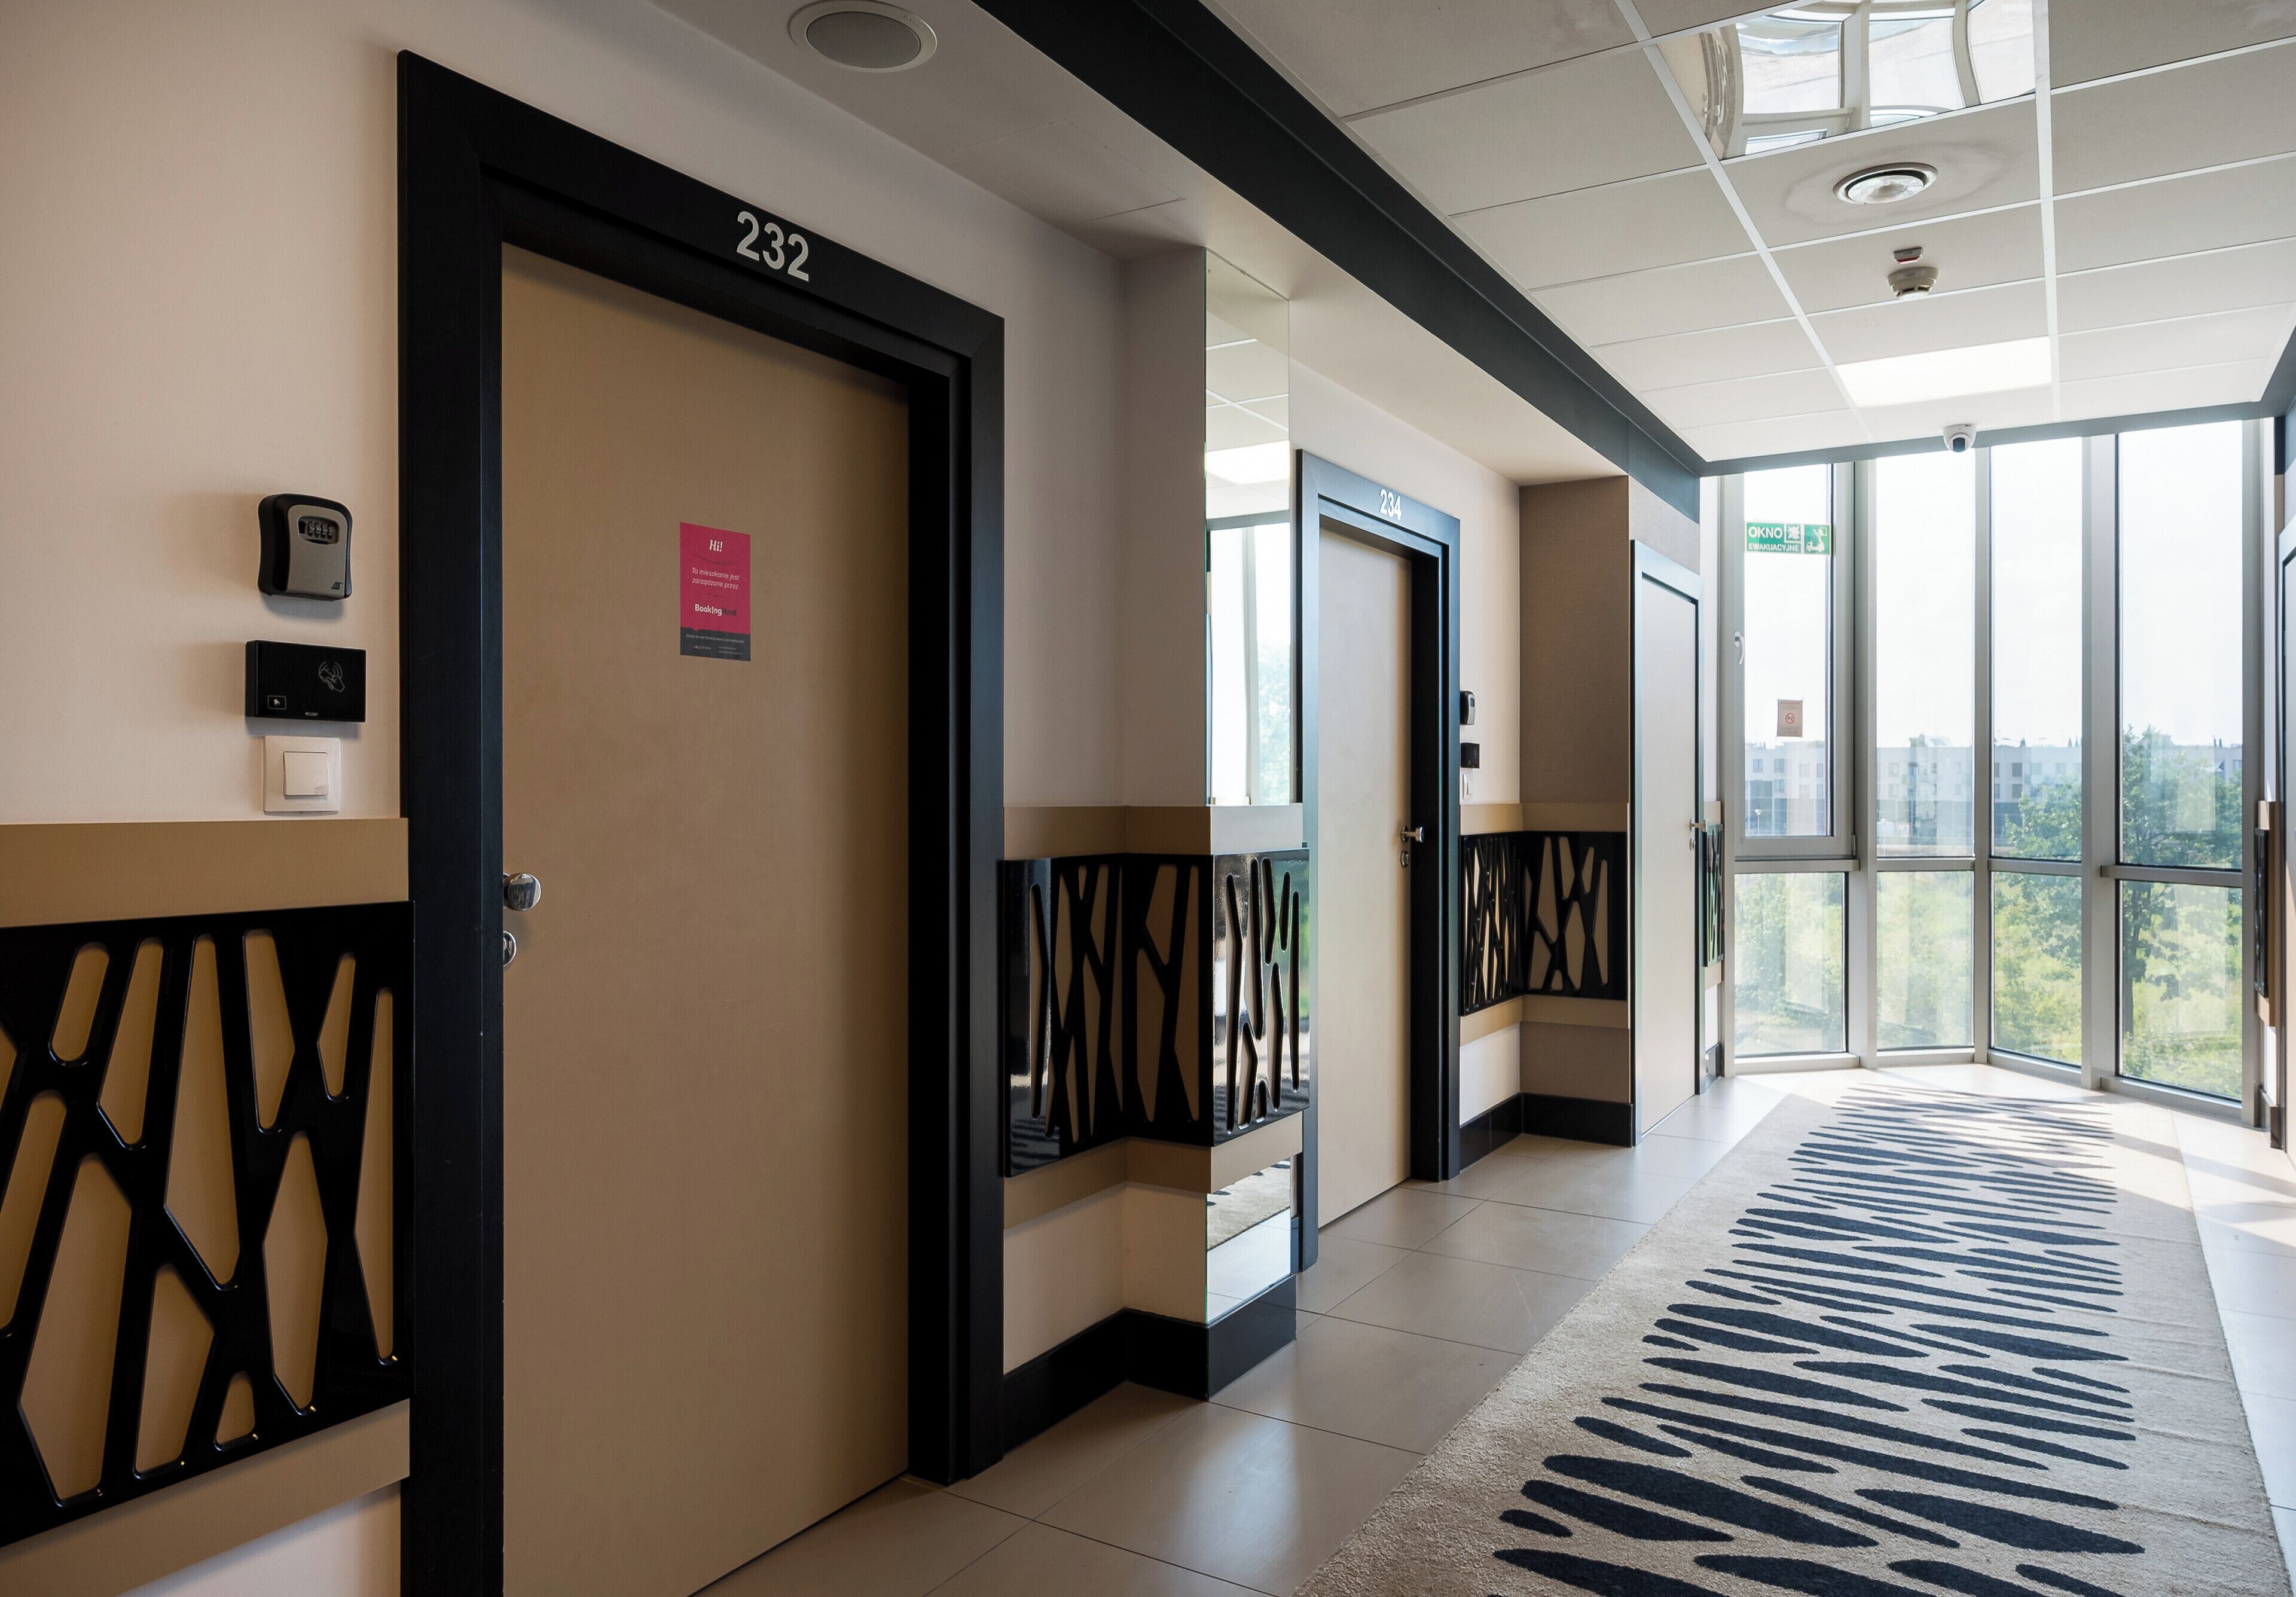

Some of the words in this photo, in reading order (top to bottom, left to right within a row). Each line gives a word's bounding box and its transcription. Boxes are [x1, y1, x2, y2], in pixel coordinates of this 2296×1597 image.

[737, 211, 809, 282] 232
[1379, 488, 1402, 521] 234
[1748, 526, 1783, 539] OKNO
[709, 539, 723, 552] Hi!
[1748, 543, 1799, 551] EWAKUACYJNE
[699, 570, 729, 579] mieszkanie
